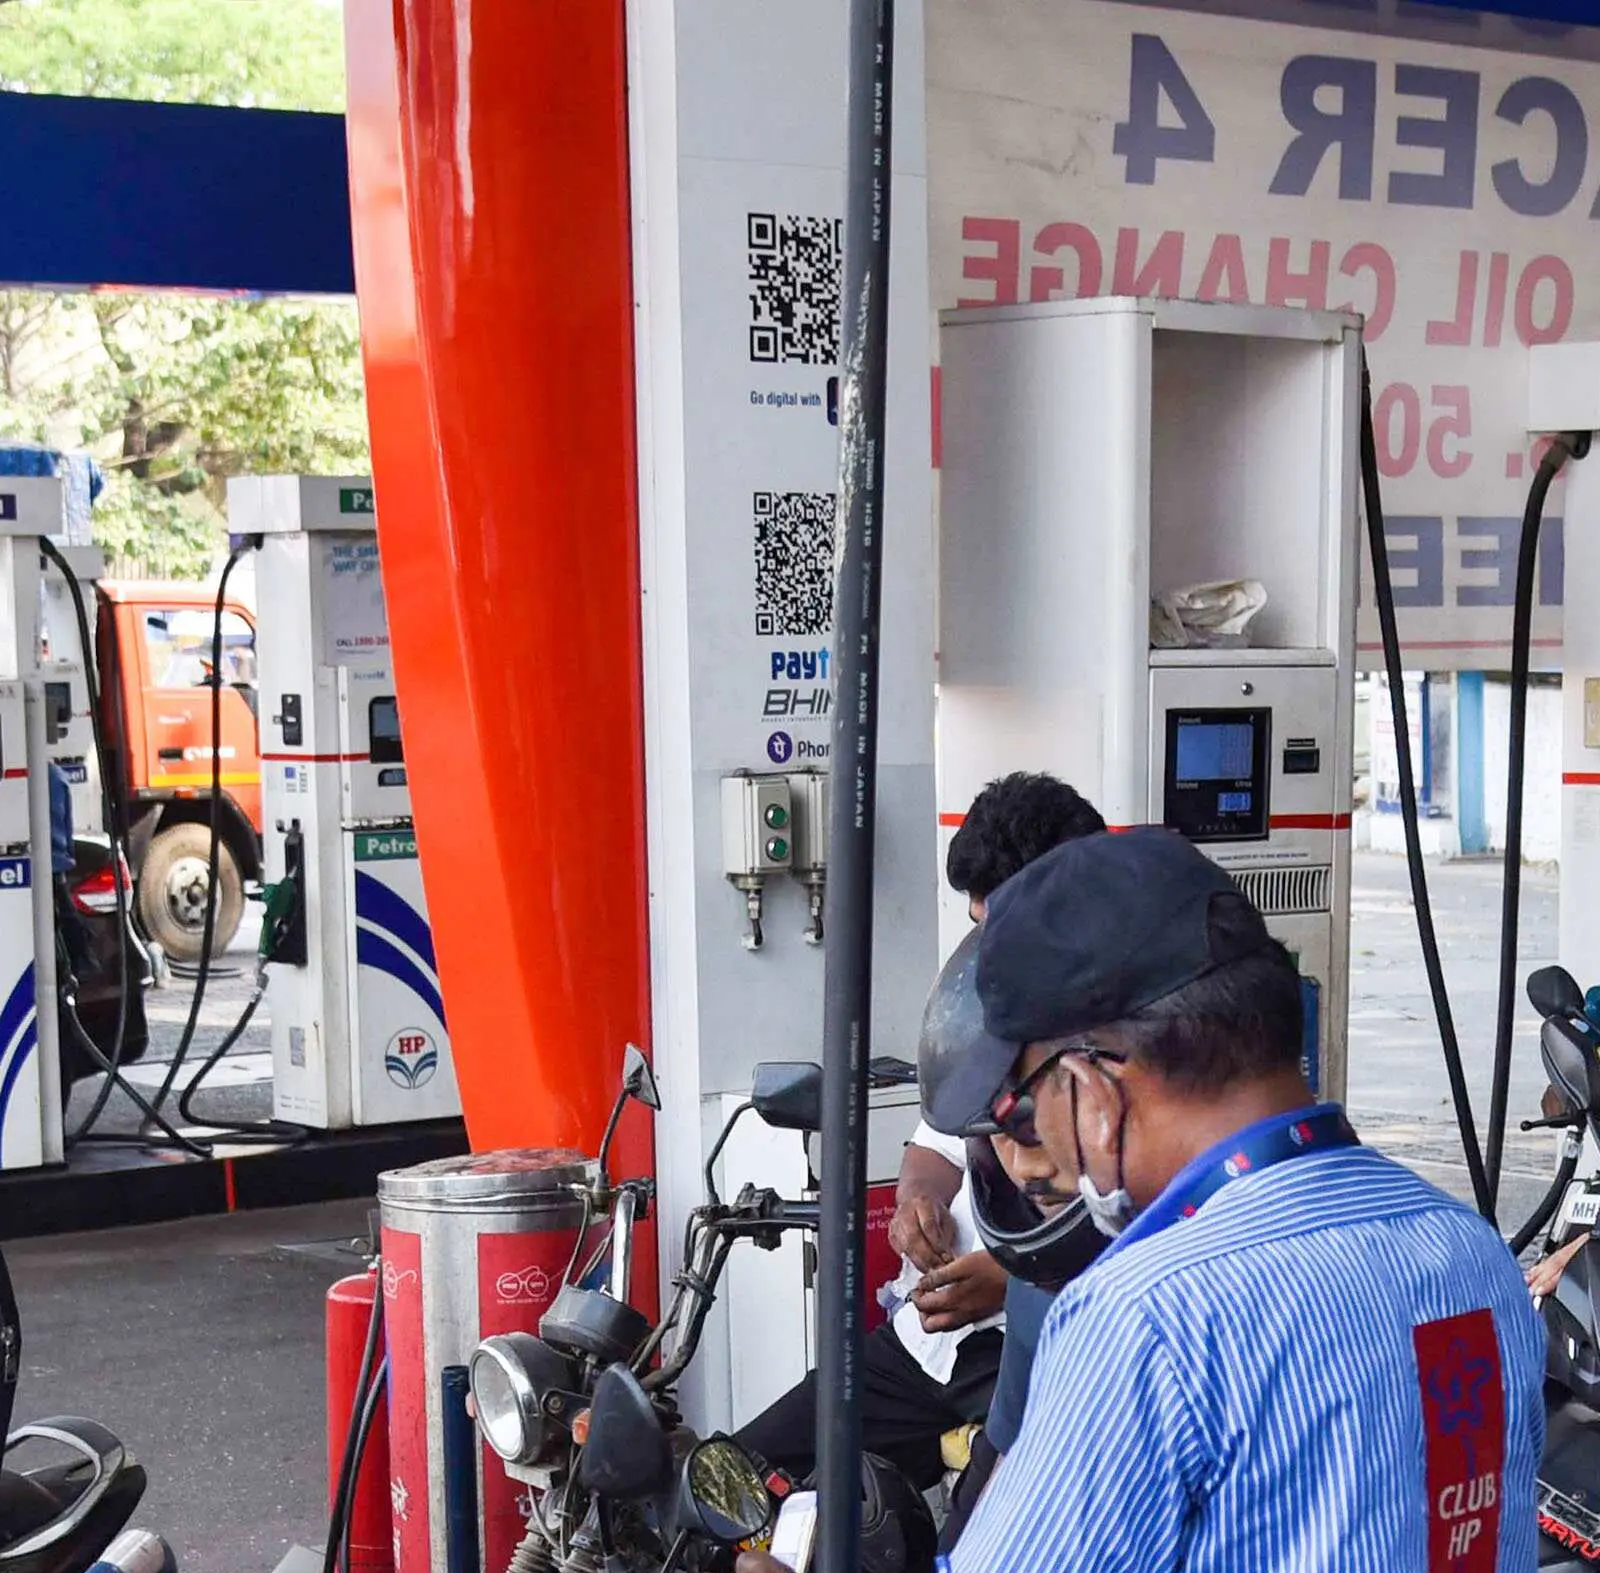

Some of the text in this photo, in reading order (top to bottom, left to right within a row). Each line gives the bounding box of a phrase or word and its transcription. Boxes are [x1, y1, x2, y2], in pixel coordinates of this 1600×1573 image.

[750, 391, 821, 408] Go digital with
[367, 838, 417, 856] Petro
[398, 1036, 426, 1053] HP
[1438, 1473, 1498, 1520] CLUB
[1448, 1519, 1482, 1561] HP
